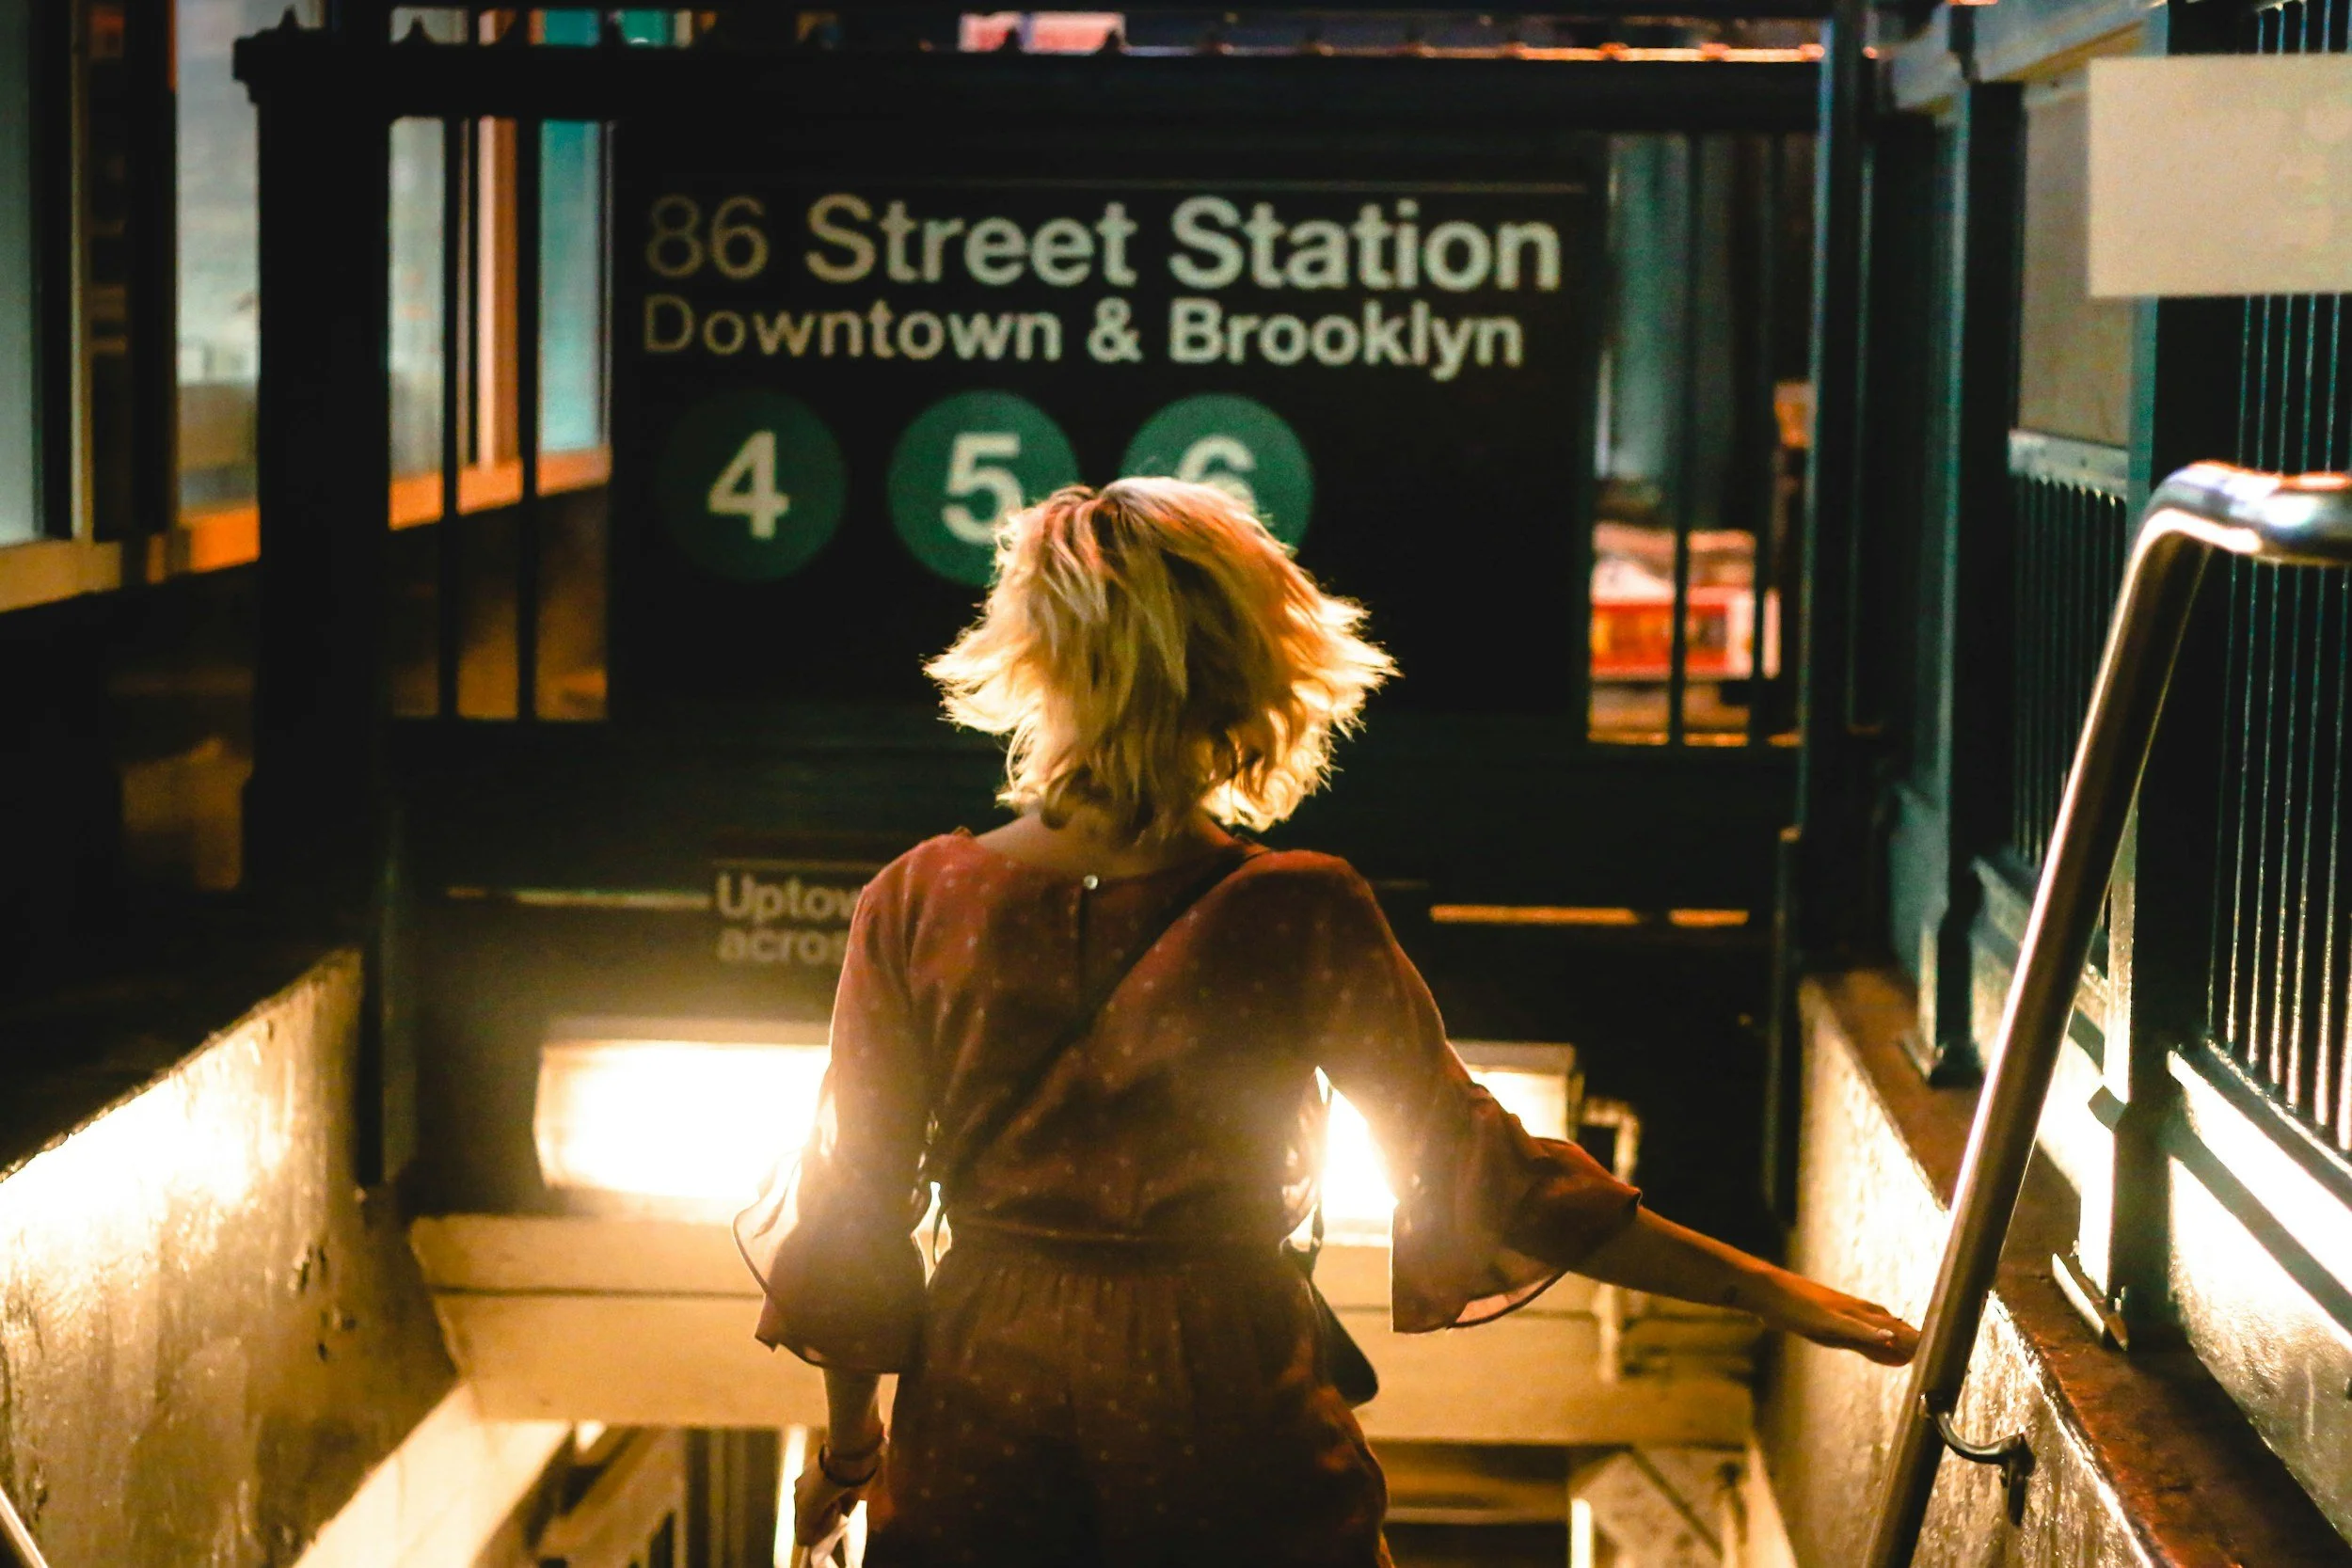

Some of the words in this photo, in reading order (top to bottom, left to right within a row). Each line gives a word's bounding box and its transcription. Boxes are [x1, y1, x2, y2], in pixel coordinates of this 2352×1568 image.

[646, 194, 769, 279] 86
[804, 193, 1136, 286] Street
[1168, 194, 1561, 291] Station
[644, 293, 1063, 360] Downtown
[1087, 296, 1142, 363] &
[1168, 297, 1523, 381] Brooklyn
[707, 430, 790, 539] 4
[942, 432, 1025, 545] 5
